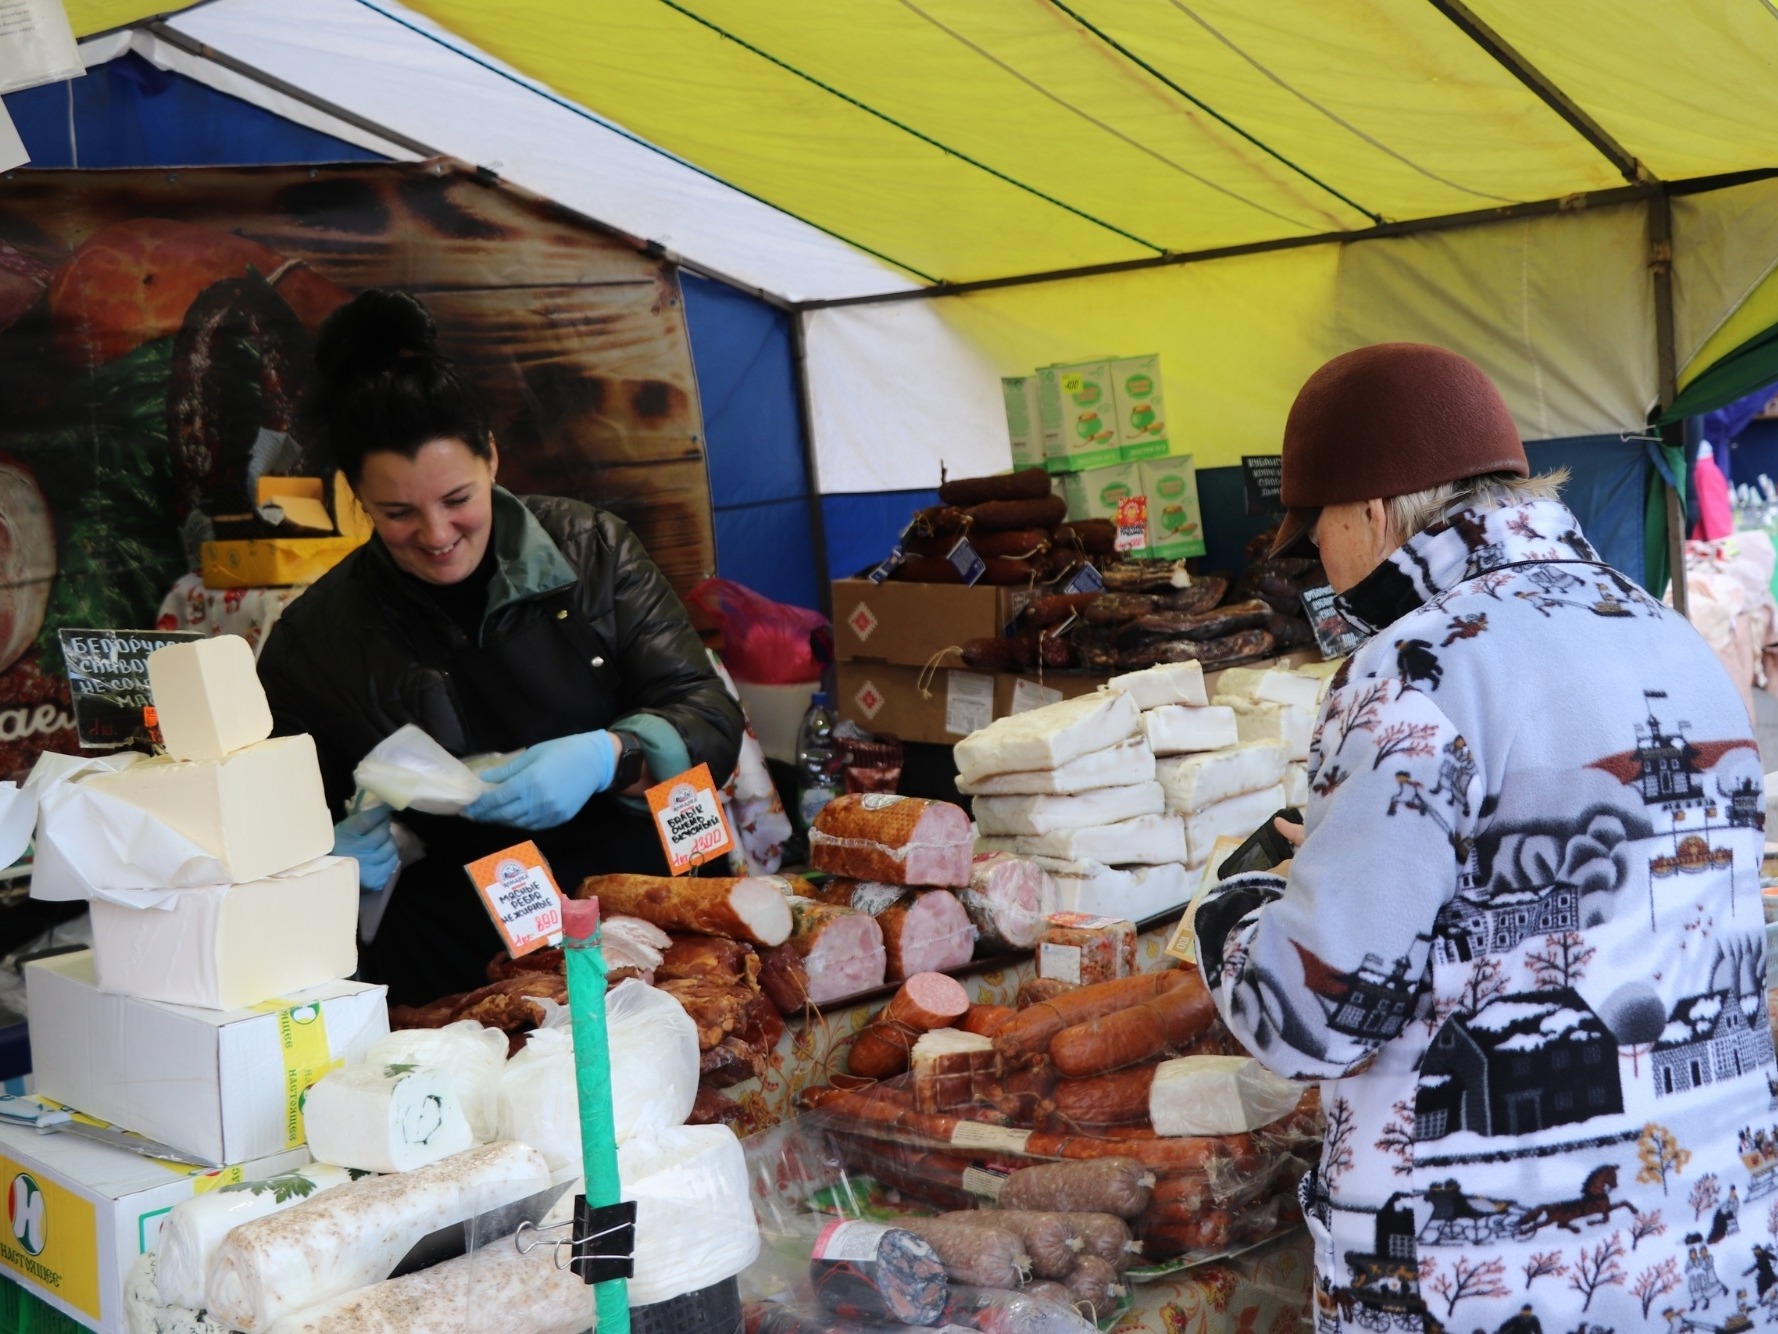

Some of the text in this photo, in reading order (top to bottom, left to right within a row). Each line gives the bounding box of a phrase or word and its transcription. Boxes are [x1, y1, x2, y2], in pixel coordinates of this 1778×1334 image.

[78, 680, 106, 694] НЕ
[667, 804, 704, 827] БАЛЫК
[671, 815, 706, 835] ОЧЕНЬ
[671, 815, 721, 844] ВКУСНЫЙ
[691, 828, 722, 852] 1300
[499, 880, 541, 905] МЯСНЫЕ
[510, 891, 543, 910] РЕБРА
[501, 897, 554, 924] НЕЖИРНЫЕ
[535, 910, 559, 931] 890
[288, 1068, 298, 1142] НАСТОЯЩЕЕ
[0, 1243, 61, 1288] НАСТОЯЩЕЕ
